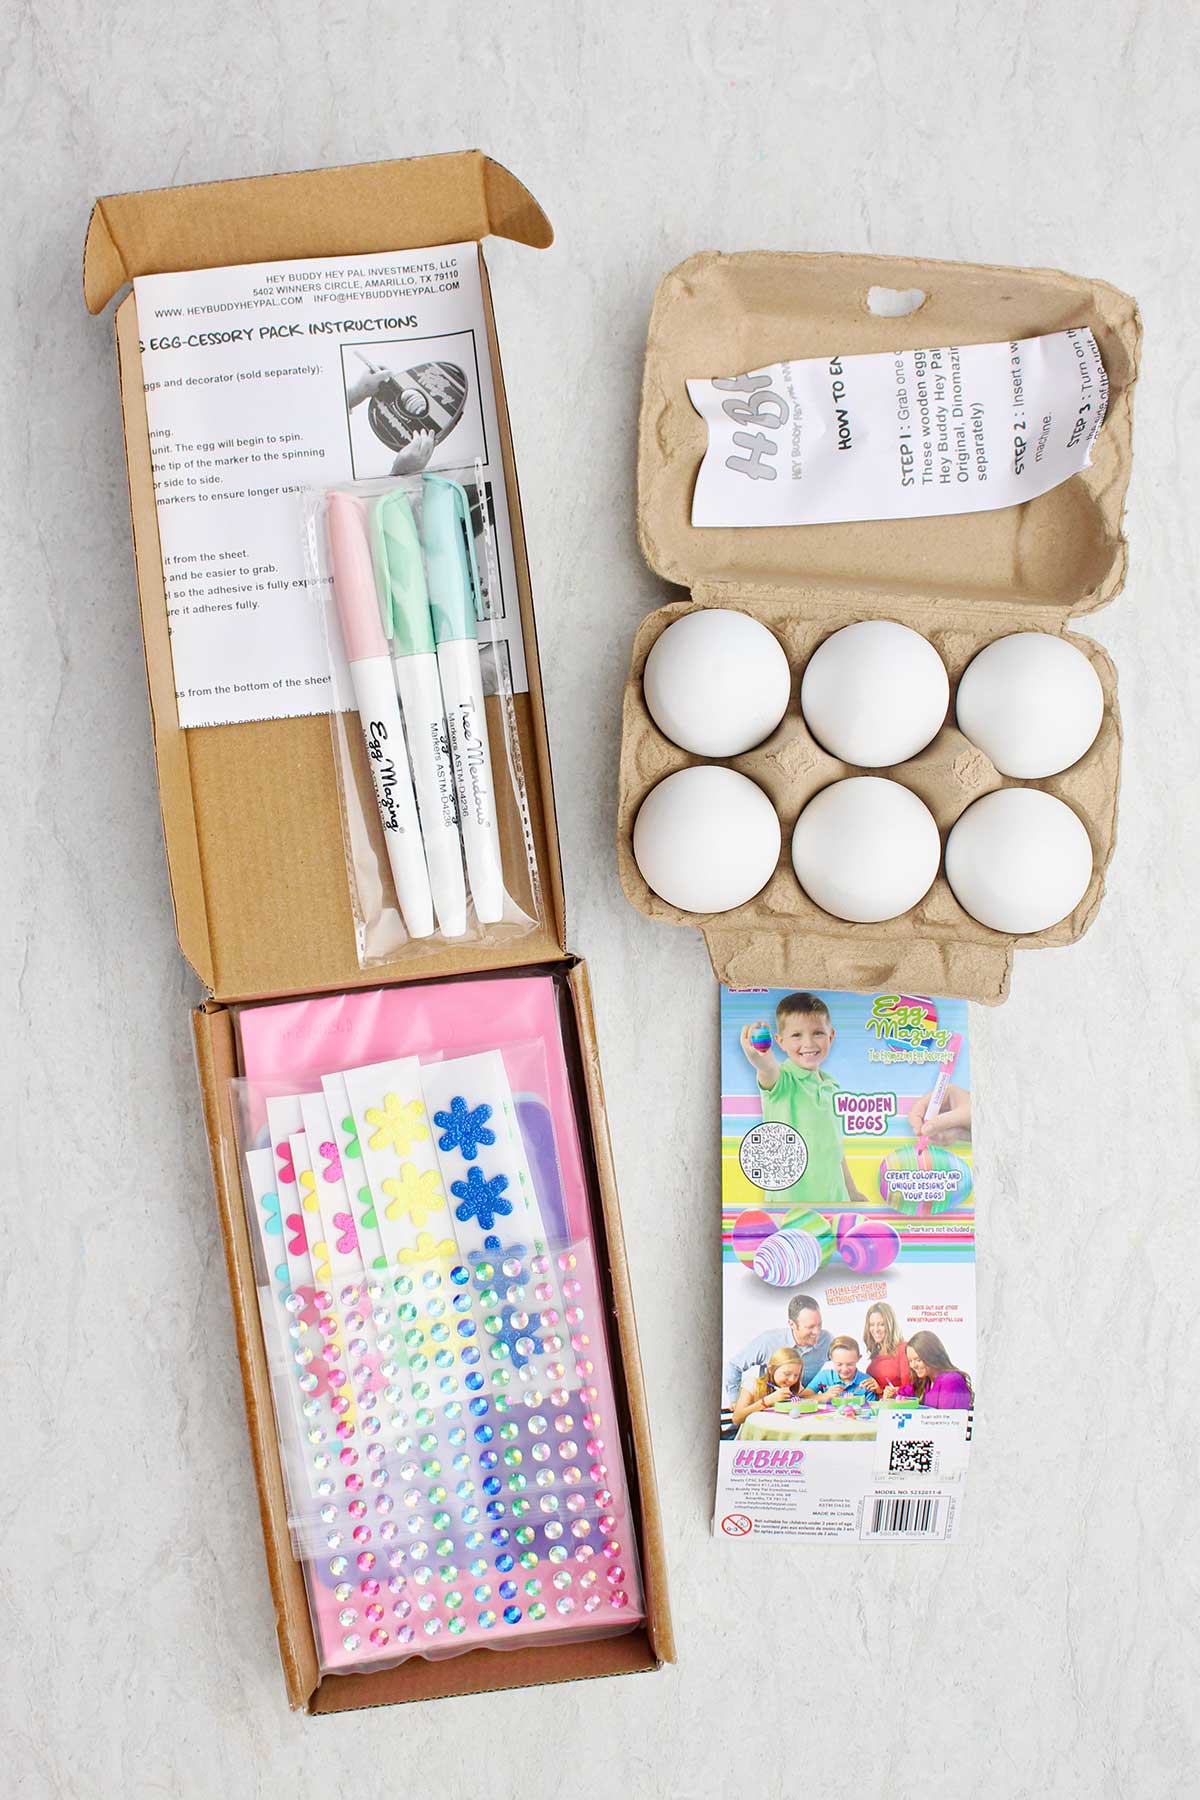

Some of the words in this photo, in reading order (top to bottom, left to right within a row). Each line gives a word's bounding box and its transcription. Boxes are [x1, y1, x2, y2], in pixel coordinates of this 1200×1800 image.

[253, 287, 274, 296] 5402
[277, 283, 321, 294] WINNERS
[324, 280, 362, 291] CIRCLE,
[365, 277, 417, 288] AMARILLO,
[420, 275, 431, 284] TX
[434, 270, 459, 282] 79110
[266, 275, 285, 284] HEY
[289, 272, 322, 282] BUDDY
[325, 270, 343, 279] HEY
[347, 268, 364, 277] PAL
[368, 263, 438, 276] INVESTMENTS,
[440, 259, 457, 269] LLC
[154, 309, 185, 318] WWW.
[187, 296, 304, 315] HEYBUDDYHEYPAL.COM
[314, 281, 460, 303] INFO@HEYBUDDYHEYPAL.COM
[150, 328, 254, 351] EGG-CESSORY
[259, 324, 304, 340] PACK
[309, 315, 418, 335] INSTRUCTIONS
[930, 348, 942, 369] Pal
[1011, 356, 1020, 365] a
[1072, 341, 1085, 358] on
[164, 378, 183, 388] and
[185, 373, 234, 386] decorator
[236, 369, 262, 382] (sold
[264, 365, 324, 379] separately):
[895, 360, 905, 384] one
[1079, 362, 1093, 392] Turn
[832, 381, 846, 403] TO
[934, 374, 947, 401] Hey
[1011, 368, 1024, 407] Insert
[896, 388, 910, 420] Grab
[917, 381, 932, 437] wooden
[792, 422, 801, 457] BUDDY
[835, 409, 852, 450] HOW
[936, 406, 949, 452] Buddy
[970, 402, 988, 481] separately)
[1035, 411, 1052, 462] machine.
[1067, 418, 1087, 448] STEP
[152, 446, 173, 455] unit.
[176, 443, 194, 452] The
[196, 442, 215, 451] egg
[217, 440, 235, 449] will
[237, 437, 264, 447] begin
[267, 435, 277, 443] to
[279, 433, 304, 442] spin.
[954, 422, 970, 483] Original,
[1014, 436, 1027, 475] STEP
[152, 463, 166, 472] the
[168, 461, 181, 471] tip
[184, 459, 195, 468] of
[196, 458, 212, 467] the
[214, 455, 249, 465] marker
[251, 454, 262, 462] to
[264, 452, 279, 461] the
[282, 448, 326, 460] spinning
[900, 443, 914, 487] STEP
[922, 441, 933, 485] These
[939, 457, 952, 484] Hey
[164, 478, 184, 487] side
[187, 477, 197, 485] to
[200, 475, 223, 485] side.
[156, 495, 196, 506] markers
[199, 493, 209, 501] to
[211, 491, 245, 500] ensure
[248, 487, 279, 499] longer
[164, 557, 171, 565] it
[173, 555, 197, 564] from
[200, 553, 216, 562] the
[219, 550, 250, 560] sheet.
[169, 573, 188, 582] and
[191, 571, 203, 580] be
[206, 569, 236, 578] easier
[239, 567, 250, 575] to
[252, 564, 279, 575] grab.
[174, 590, 186, 599] so
[188, 588, 205, 597] the
[207, 584, 253, 595] adhesive
[255, 583, 265, 591] is
[267, 580, 289, 590] fully
[183, 607, 190, 615] it
[192, 604, 233, 614] adheres
[236, 600, 261, 610] fully.
[188, 687, 212, 697] from
[215, 685, 231, 694] the
[233, 681, 270, 692] bottom
[272, 680, 283, 689] of
[285, 678, 301, 687] the
[304, 675, 332, 685] sheet
[368, 721, 388, 762] Egg
[430, 722, 442, 761] Markers
[436, 763, 453, 828] ASTM-D4236
[449, 712, 458, 751] Markers
[454, 754, 469, 817] ASTM-D4236
[872, 994, 928, 1026] Egg
[865, 1018, 952, 1047] Mazing
[837, 1097, 892, 1113] WOODEN
[847, 1115, 884, 1131] EGGS
[886, 1172, 910, 1180] CREATE
[912, 1172, 947, 1180] COLORFUL
[948, 1172, 961, 1180] AND
[918, 1182, 944, 1190] DESIGNS
[925, 1192, 944, 1200] EGGS!
[735, 1449, 804, 1468] HBHP
